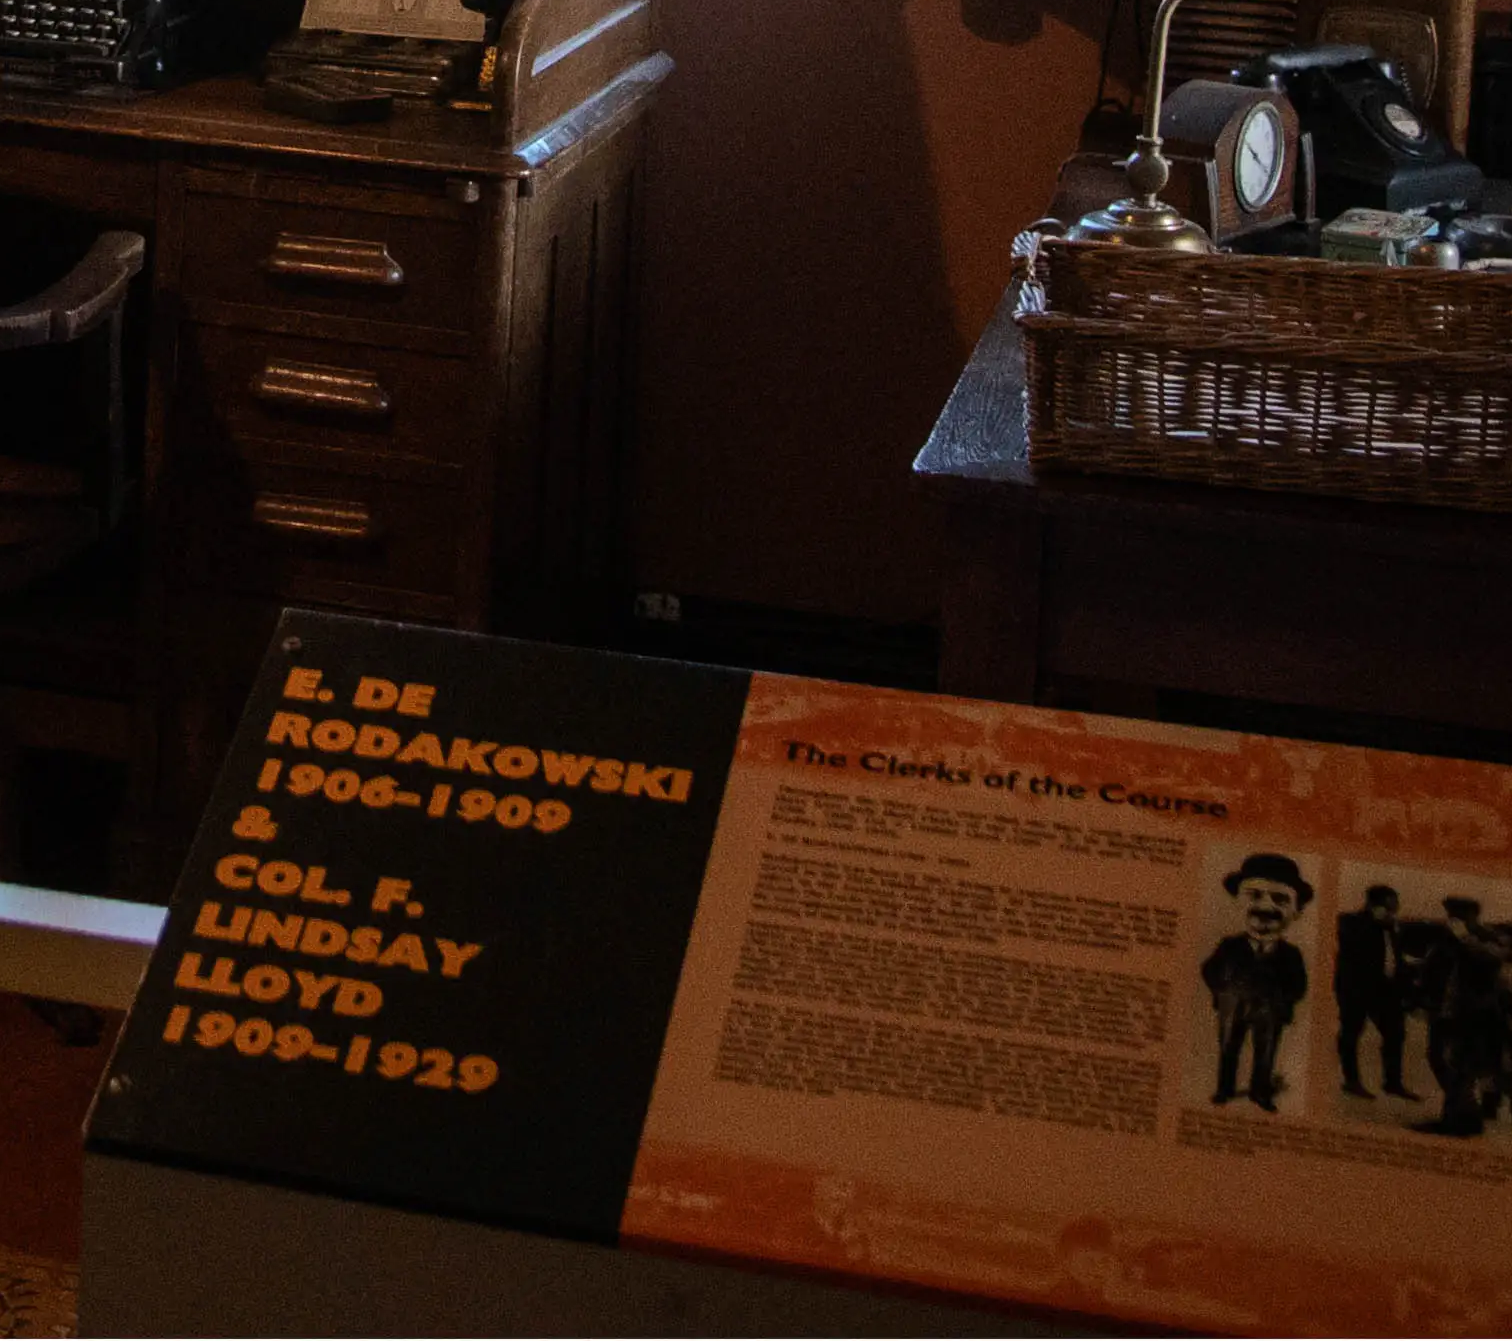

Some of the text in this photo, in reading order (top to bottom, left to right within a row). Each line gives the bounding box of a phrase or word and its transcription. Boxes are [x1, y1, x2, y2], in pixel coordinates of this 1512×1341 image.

[283, 667, 436, 717] E. DE
[266, 712, 694, 803] RODAKOWSKI
[781, 740, 1230, 818] The Clerks of the Course
[232, 805, 278, 842] &
[257, 758, 572, 834] 1906-1909
[214, 854, 425, 918] COL. F.
[193, 900, 484, 979] LINDSAY
[175, 951, 384, 1018] LLOYD
[162, 1005, 500, 1094] 1909-1929
